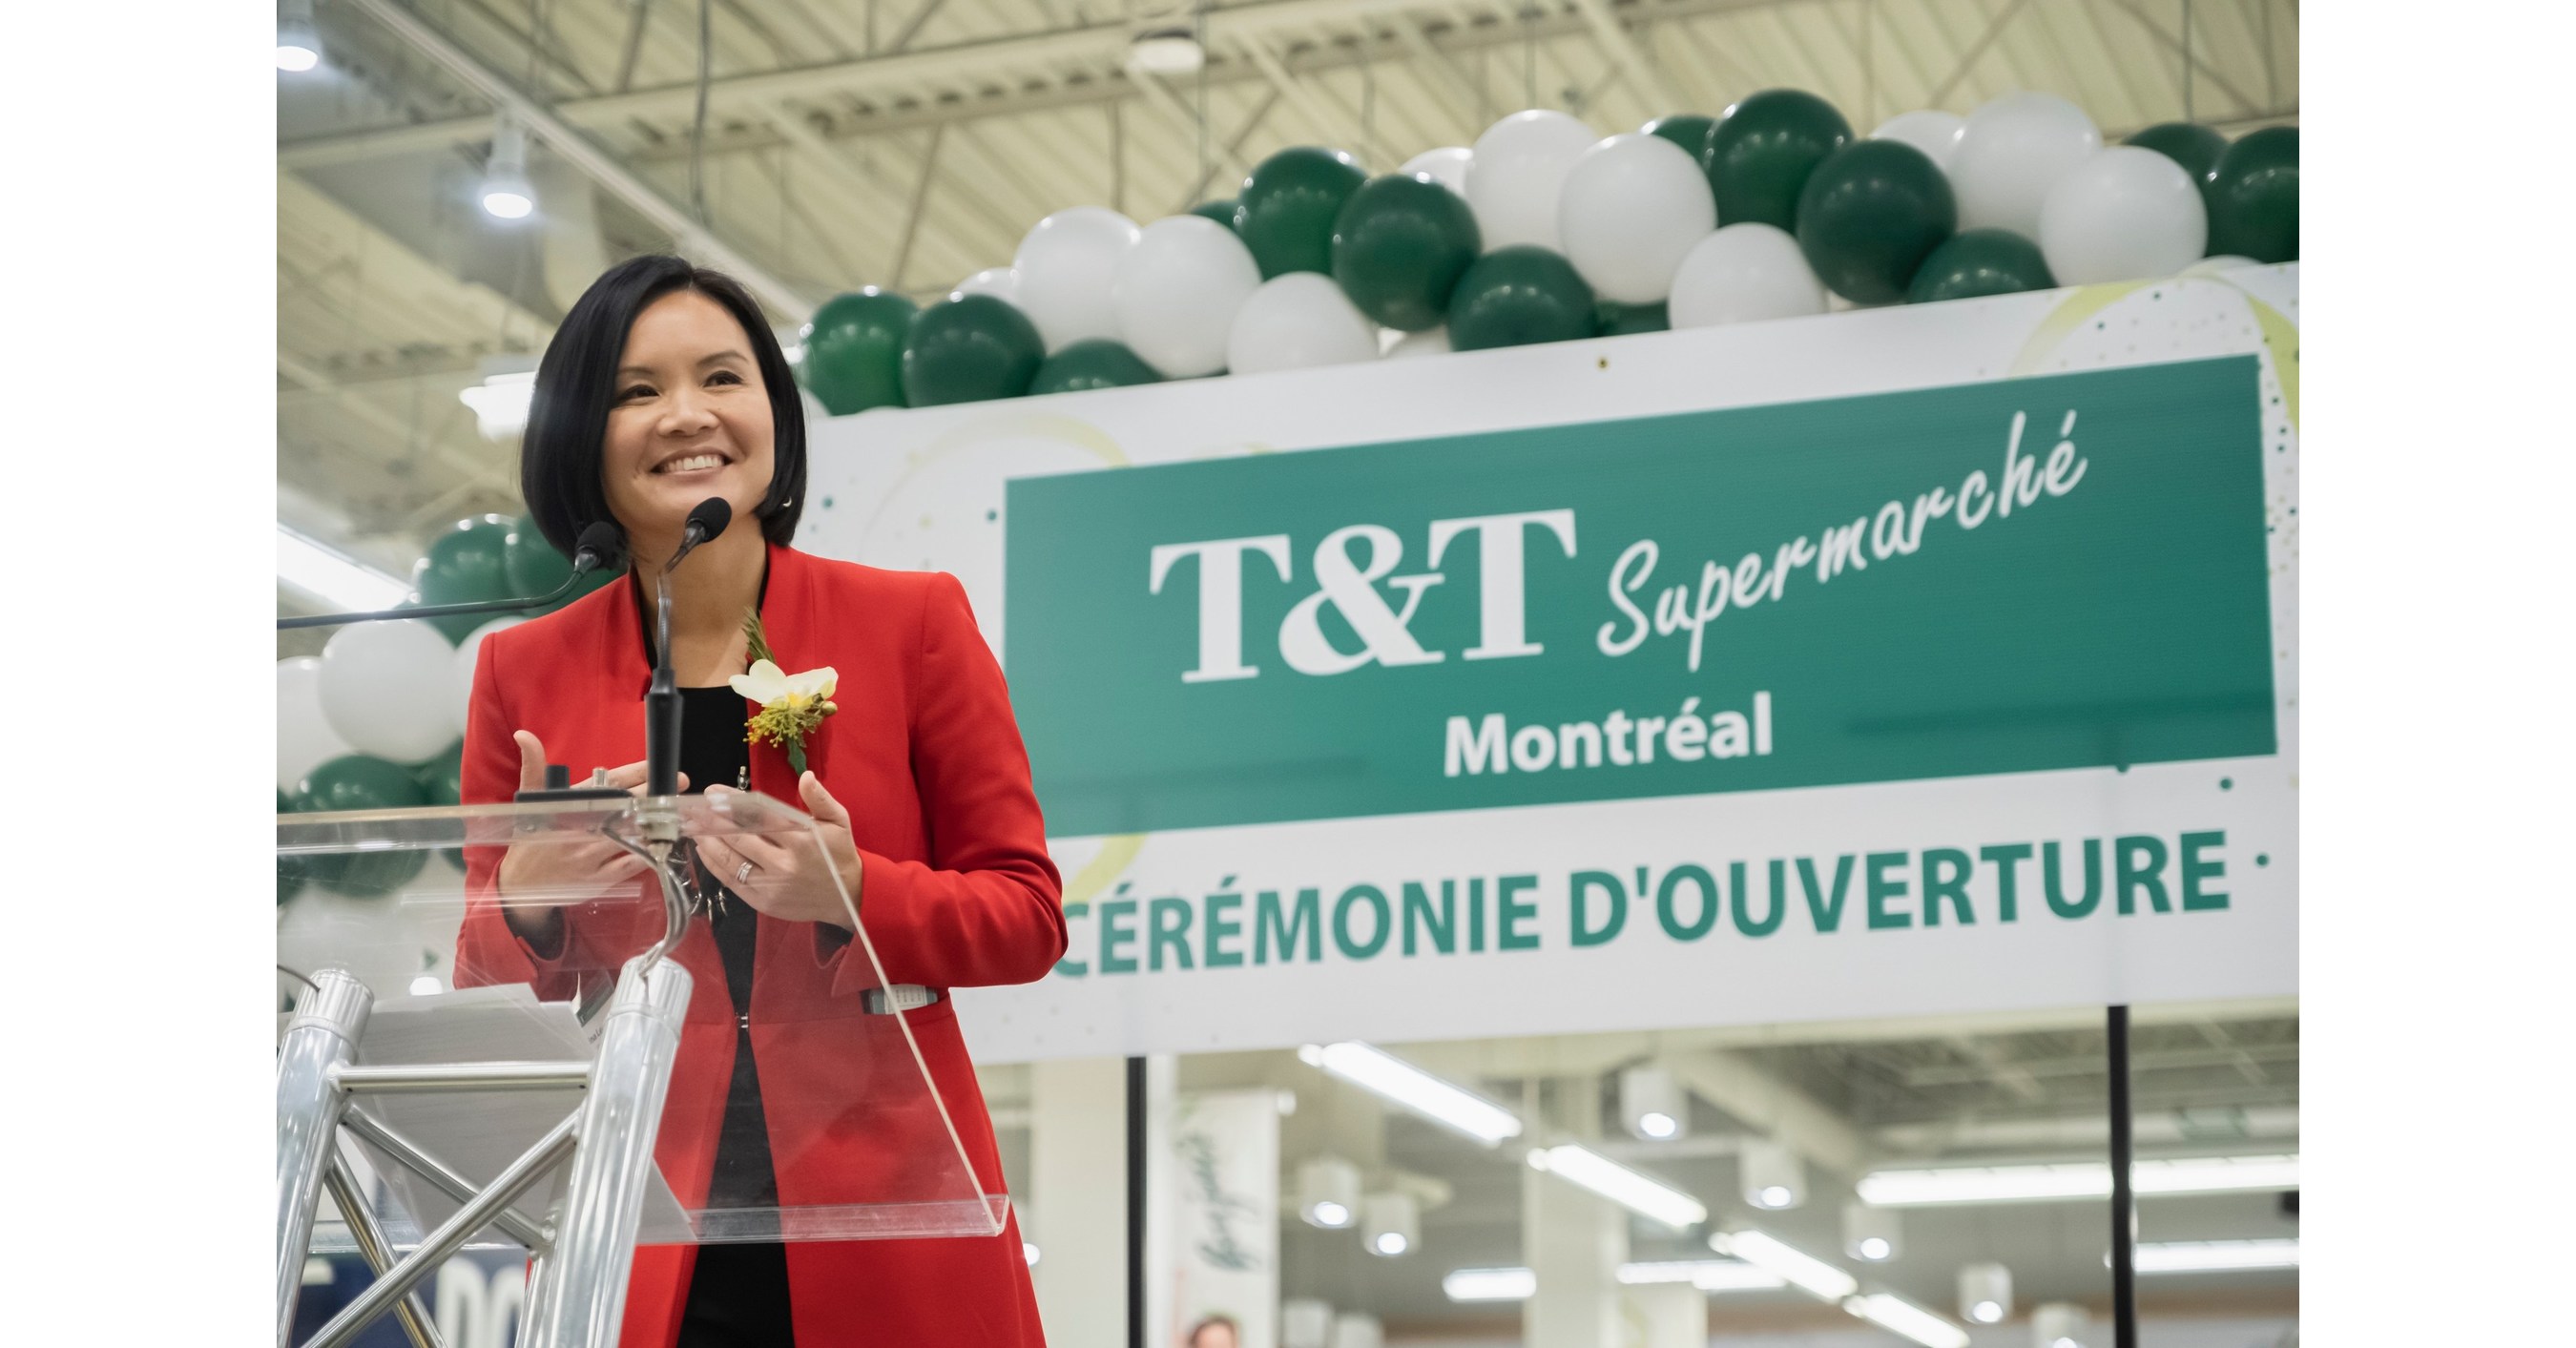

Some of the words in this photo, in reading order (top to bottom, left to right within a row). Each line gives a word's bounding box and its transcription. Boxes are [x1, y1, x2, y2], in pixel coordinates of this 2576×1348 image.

[1150, 508, 1577, 683] T&T
[1596, 409, 2088, 673] Supermarché
[1444, 690, 1773, 778] Montréal
[1568, 830, 2231, 947] D'OUVERTURE
